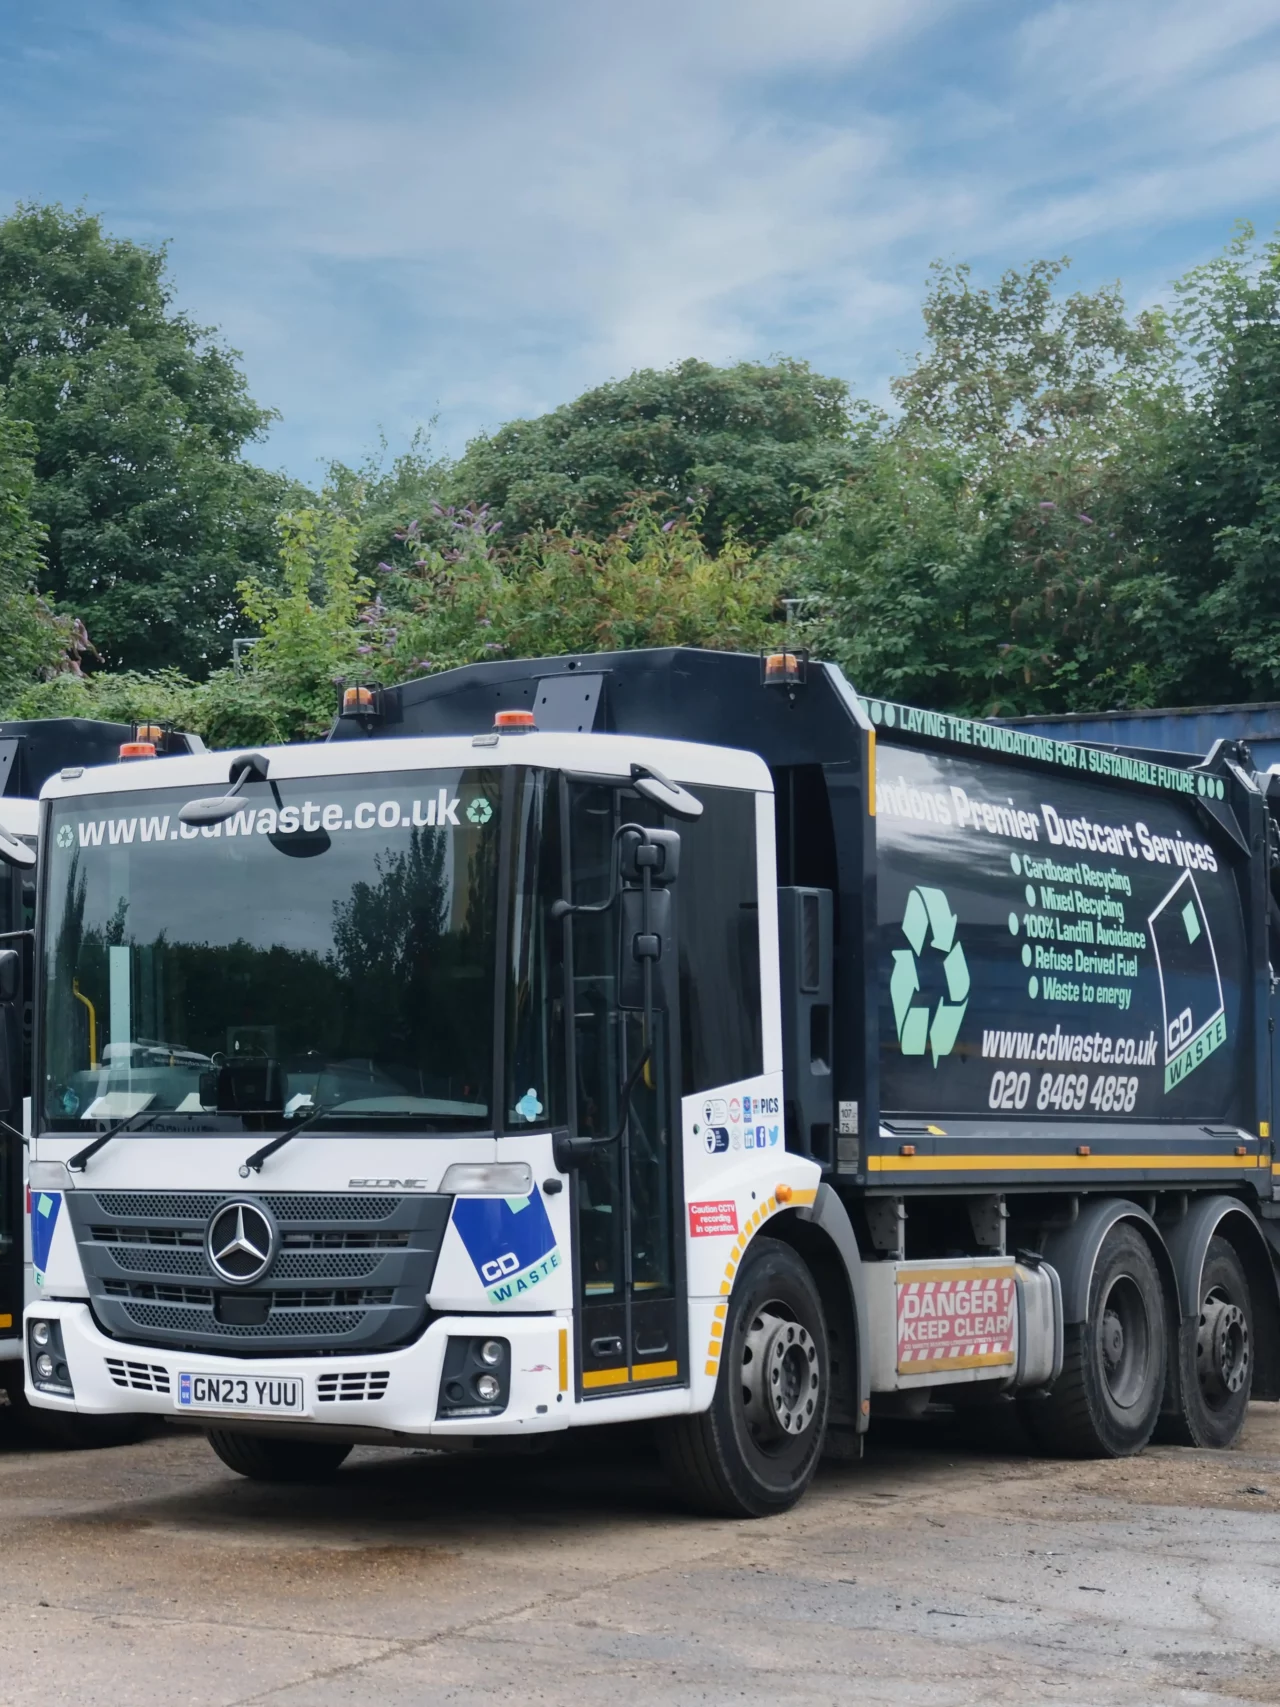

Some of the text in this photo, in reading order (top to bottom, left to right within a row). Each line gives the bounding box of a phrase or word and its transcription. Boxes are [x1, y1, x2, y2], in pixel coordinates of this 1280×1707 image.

[900, 707, 1195, 794] LAYING THE FOUNDATIONS FOR A SUSTAINABLE FUTURE
[876, 776, 1218, 872] ndons Premier Dustcart Services
[1022, 854, 1132, 897] Cardboard Recycling
[1040, 886, 1125, 923] Mixed Recycling
[1023, 914, 1146, 949] 100% Landfill Avoidance
[1035, 946, 1138, 977] Refuse Derived Fuel
[1043, 977, 1131, 1010] Waste to energy
[982, 1024, 1158, 1066] www.cdwaste.co.uk
[1169, 1007, 1193, 1050] CD
[1170, 1021, 1223, 1084] WASTE
[761, 1098, 778, 1113] PICS
[988, 1071, 1138, 1112] 020 8469 4858
[348, 1177, 428, 1188] ECONIC
[691, 1204, 735, 1214] Caution CCTV
[700, 1214, 731, 1223] recording
[481, 1252, 520, 1282] CD
[493, 1255, 559, 1301] WASTE
[904, 1316, 1008, 1341] KEEP CLEAR
[194, 1378, 296, 1406] GN23 YUU
